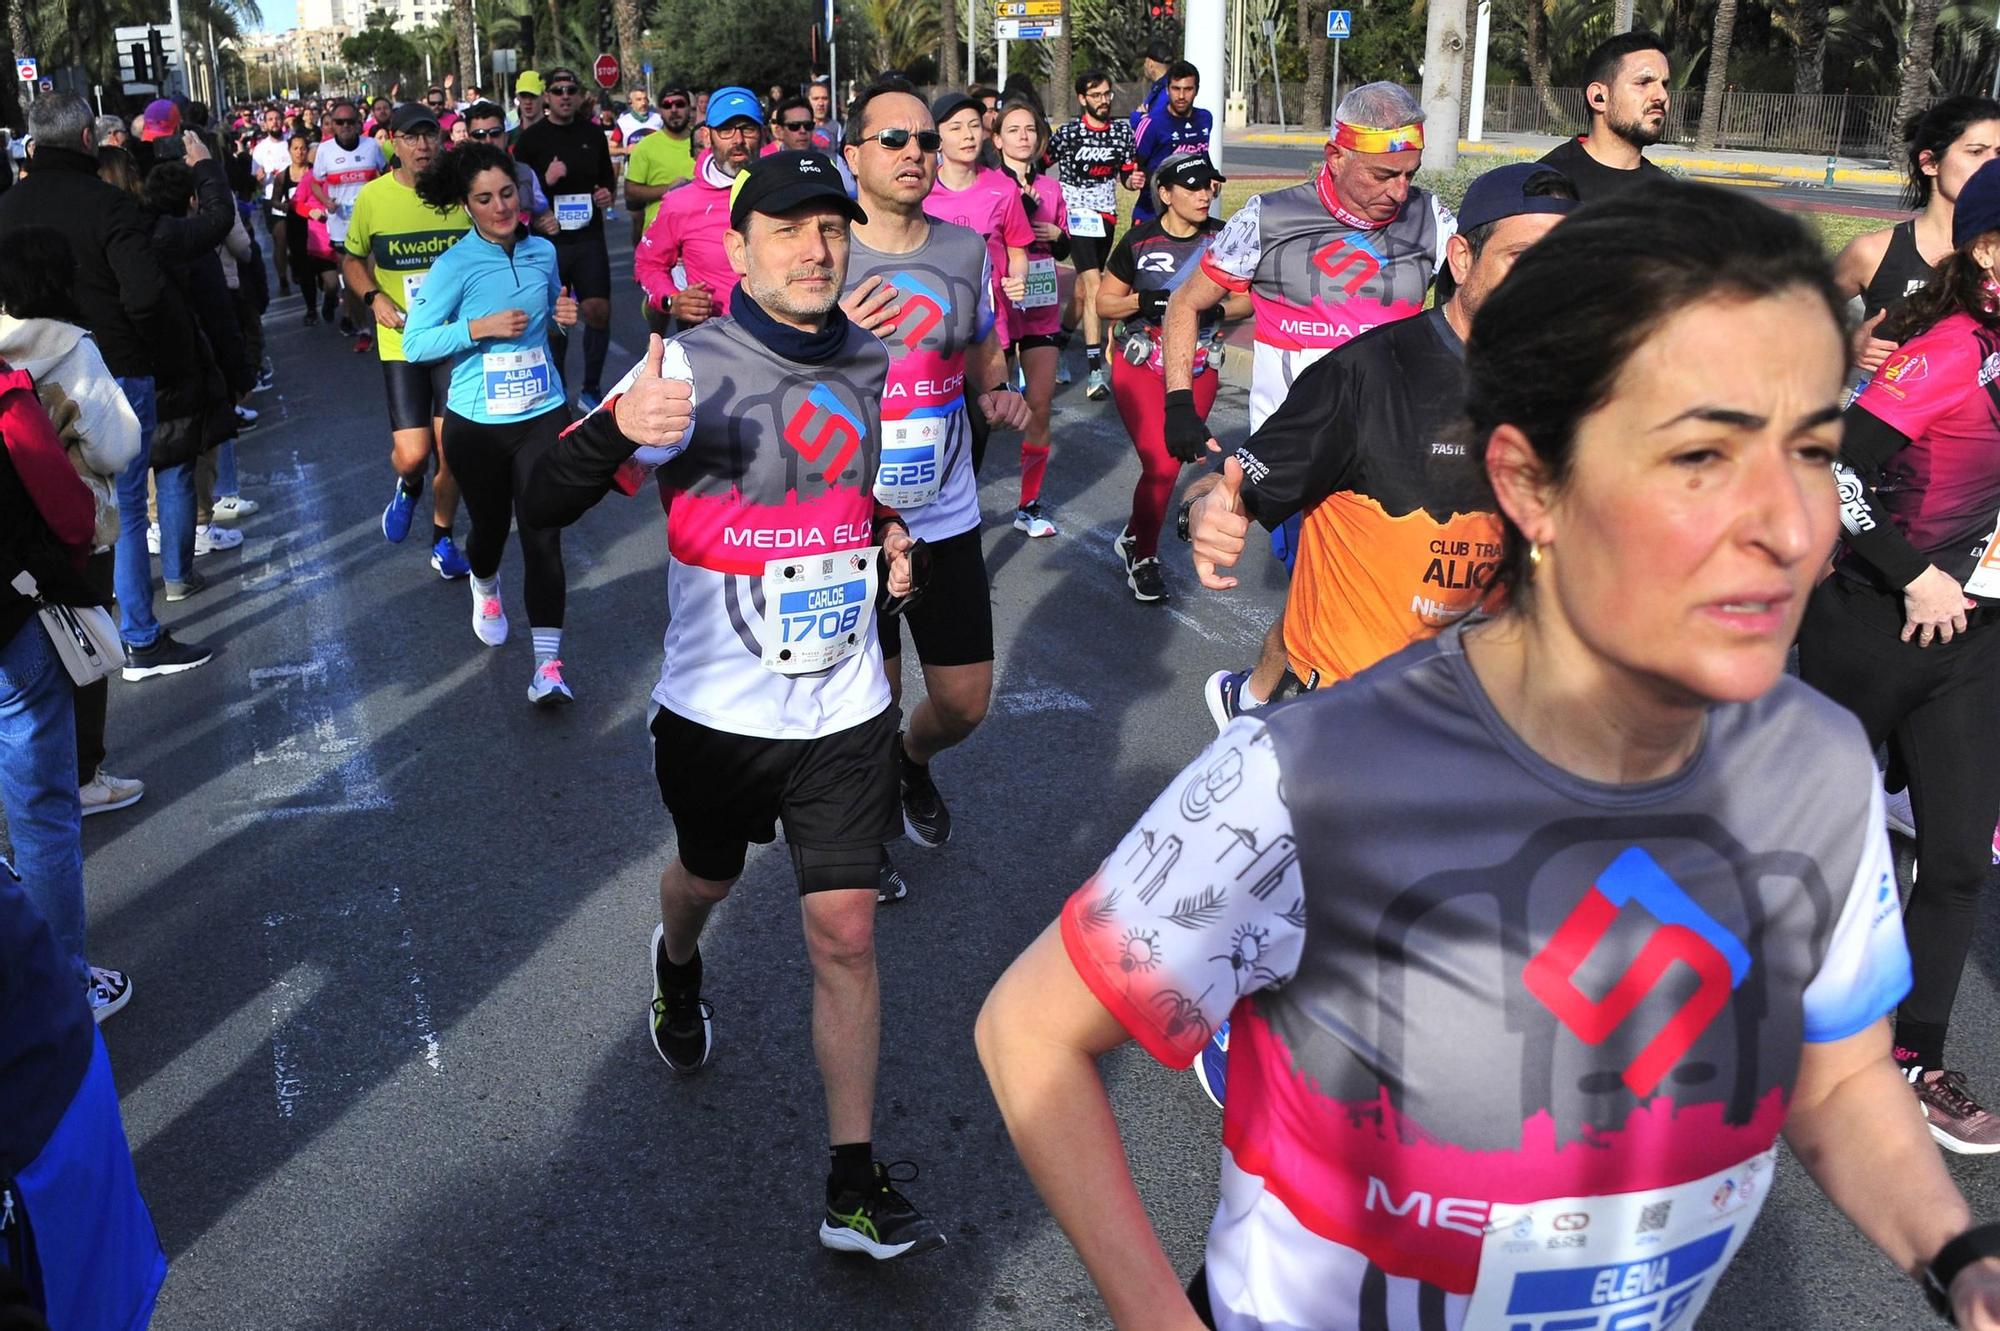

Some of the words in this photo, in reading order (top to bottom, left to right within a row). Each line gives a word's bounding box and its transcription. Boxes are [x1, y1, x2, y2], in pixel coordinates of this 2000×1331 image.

[598, 67, 617, 76] STOP
[1075, 146, 1115, 162] CORRE
[557, 211, 590, 221] 2620
[395, 258, 422, 266] RAMEN
[1280, 319, 1350, 337] MEDIA
[504, 370, 534, 381] ALBA
[914, 371, 964, 396] ELCHE
[494, 378, 543, 399] 5581
[879, 462, 936, 486] 625
[723, 527, 826, 549] MEDIA
[1429, 540, 1470, 556] CLUB
[808, 586, 845, 610] CARLOS
[781, 605, 861, 643] 1708
[1590, 1256, 1670, 1305] ELENA
